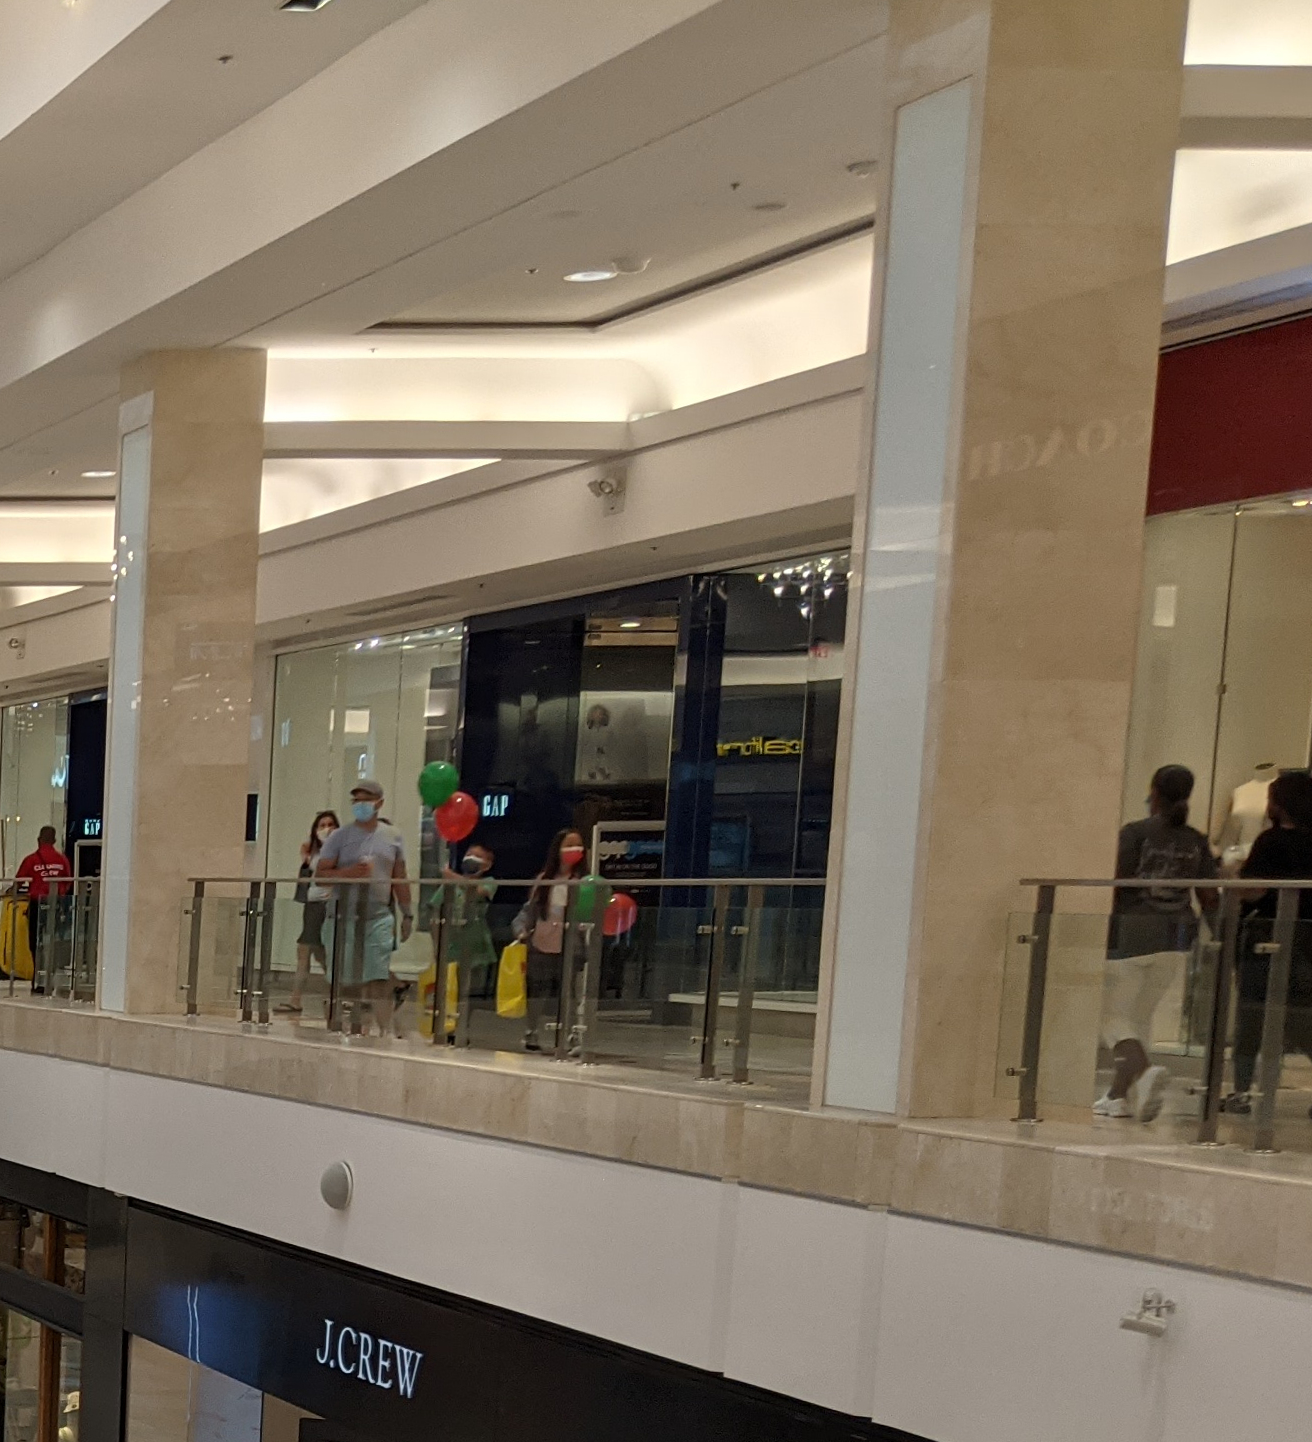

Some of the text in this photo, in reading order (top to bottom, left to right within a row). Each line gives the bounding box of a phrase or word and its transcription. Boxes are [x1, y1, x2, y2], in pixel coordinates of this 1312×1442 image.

[483, 795, 509, 817] GAP
[84, 819, 101, 836] GAP
[316, 1319, 424, 1399] J.CREW
